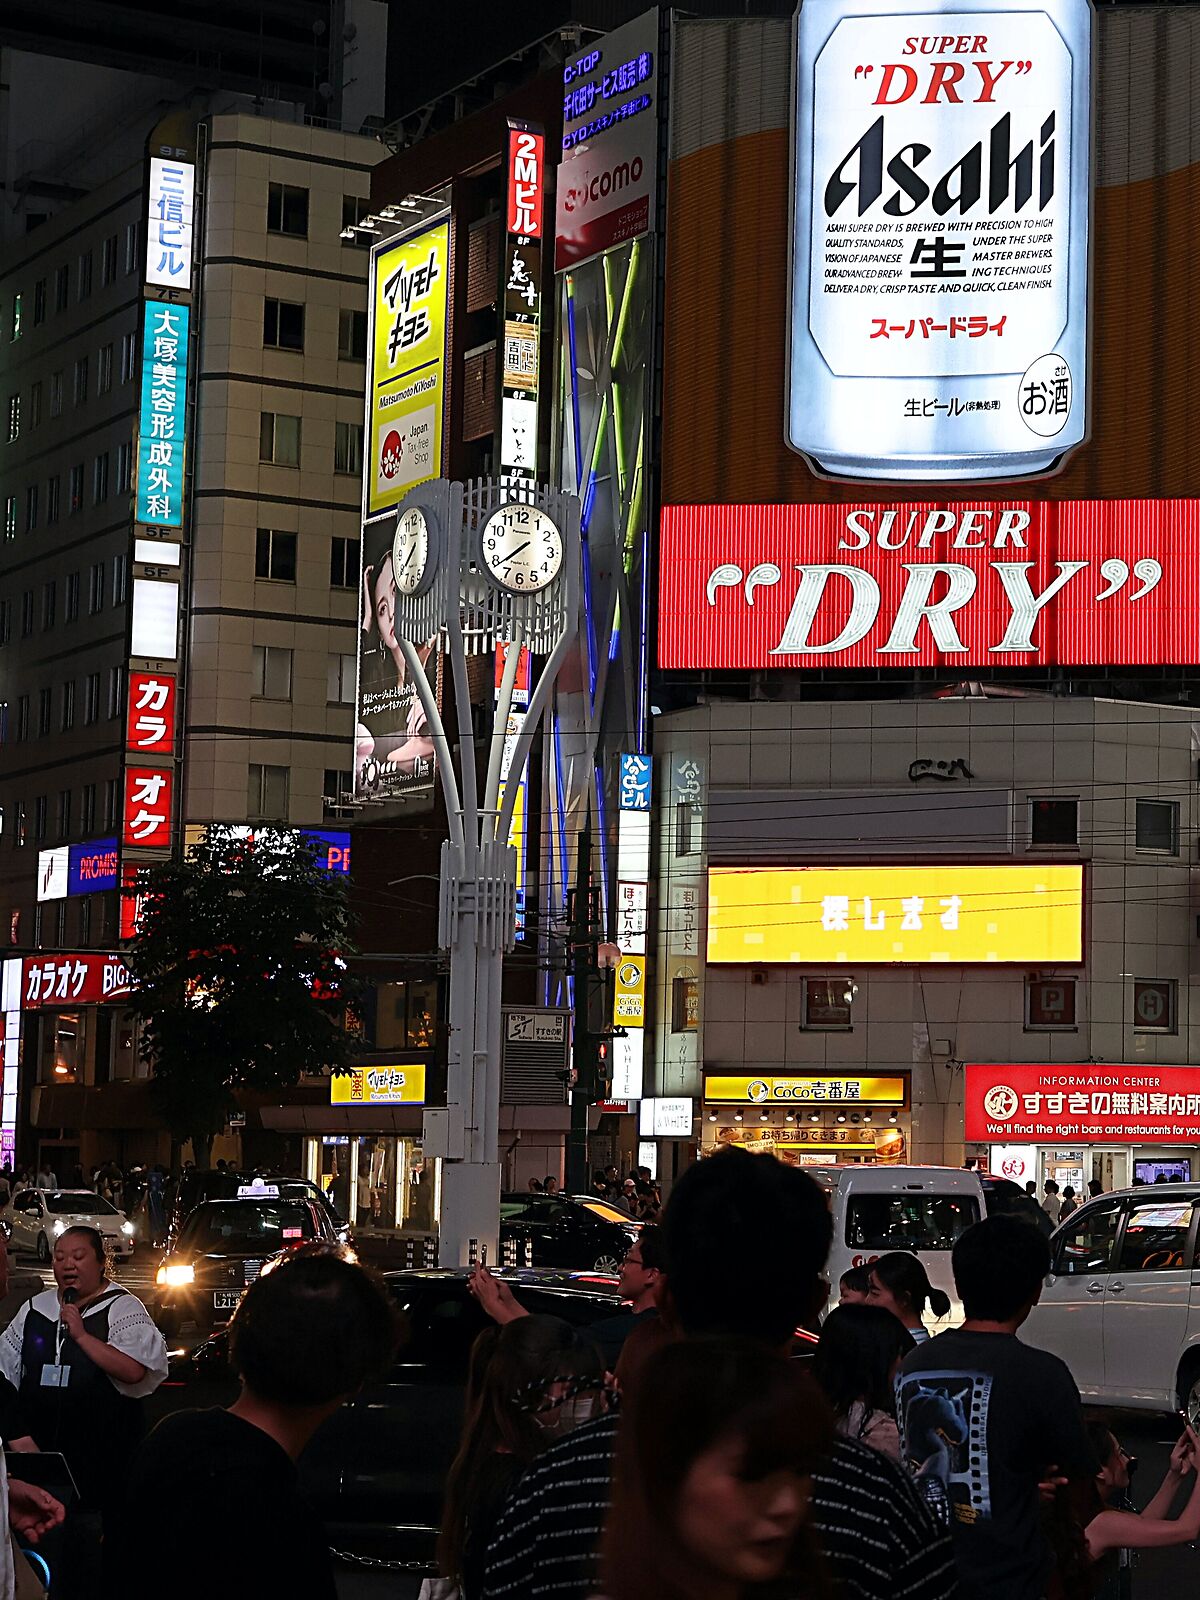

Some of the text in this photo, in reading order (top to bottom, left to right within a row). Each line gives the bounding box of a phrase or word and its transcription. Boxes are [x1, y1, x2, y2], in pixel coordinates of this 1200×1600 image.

[902, 35, 988, 55] SUPER
[564, 51, 600, 84] C-TOP
[855, 60, 1032, 105] “DRY”
[824, 109, 1056, 217] Asahi
[512, 133, 538, 234] 2Mビル
[157, 166, 184, 276] 三信ビル
[826, 219, 1053, 232] ASAHI SUPER DRY IS BREWED WITH PRECISION TO HIGH
[825, 239, 854, 248] QUALITY
[855, 239, 904, 249] STANDARDS,
[973, 236, 1007, 246] UNDER
[1008, 235, 1025, 245] THE
[825, 254, 848, 263] VISION
[848, 254, 858, 263] OF
[858, 254, 903, 263] JAPANESE
[972, 251, 1013, 261] MASTER
[910, 236, 967, 277] 生
[824, 270, 838, 278] OUR
[838, 269, 877, 278] ADVANCED
[972, 267, 991, 277] ING
[993, 265, 1052, 276] TECHNIQUES
[384, 252, 439, 313] マツモト
[824, 285, 854, 293] DELIVER
[880, 285, 906, 293] CRISP
[908, 284, 936, 294] TASTE
[938, 284, 961, 293] AND
[963, 283, 996, 293] QUICK,
[997, 282, 1024, 291] CLEAN
[515, 313, 528, 322] 7F
[870, 316, 1007, 339] スーパードライ
[388, 312, 430, 364] キヨシ
[1055, 366, 1067, 377] さけ
[1023, 378, 1069, 415] お酒
[146, 310, 180, 520] 大塚美容形成外科
[410, 422, 429, 438] Japan
[414, 452, 429, 466] Shop
[502, 514, 514, 527] 11
[515, 511, 530, 524] 12
[491, 525, 505, 537] 10
[534, 519, 540, 530] 1
[839, 509, 1031, 551] SUPER
[145, 527, 172, 538] 5F
[543, 531, 551, 543] 2
[487, 539, 496, 550] 9
[546, 547, 555, 559] 3
[492, 555, 500, 567] 8
[540, 561, 548, 573] 4
[144, 567, 170, 578] 5F
[503, 567, 512, 579] 7
[515, 573, 524, 585] 6
[530, 571, 539, 583] 5
[706, 558, 1163, 655] “DRY”
[144, 662, 164, 671] 1F
[820, 894, 963, 931] 探します
[26, 959, 88, 1001] カラオケ
[368, 1070, 405, 1090] マツモトキヨシ
[1039, 1076, 1161, 1087] INFORMATION CENTER
[773, 1081, 860, 1099] CoCo壱番屋
[986, 1123, 1012, 1134] We'll
[1013, 1123, 1034, 1134] find
[1036, 1123, 1054, 1134] the
[1055, 1123, 1080, 1136] right
[1082, 1123, 1102, 1134] bars
[1104, 1124, 1123, 1134] and
[1124, 1125, 1171, 1135] restaurants
[1172, 1125, 1185, 1135] for
